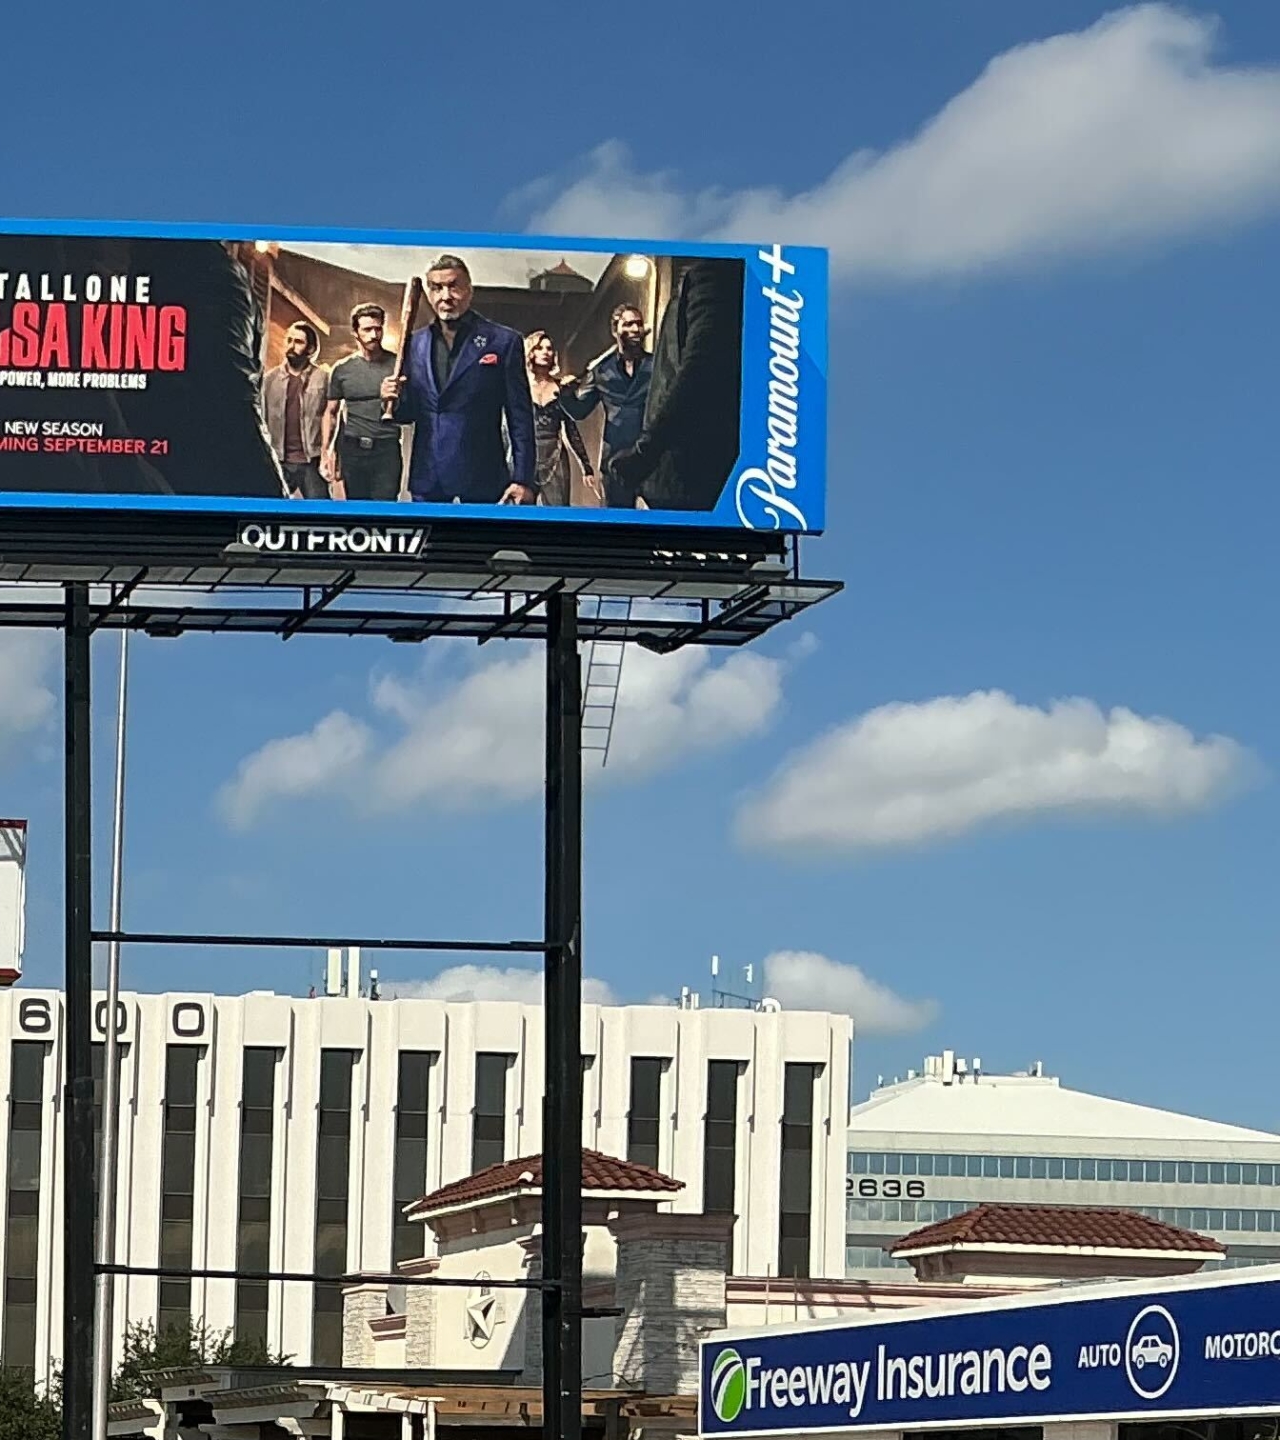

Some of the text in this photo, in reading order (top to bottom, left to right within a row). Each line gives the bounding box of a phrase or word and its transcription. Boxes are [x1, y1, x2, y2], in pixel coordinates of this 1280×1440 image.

[81, 303, 188, 371] KING
[0, 370, 45, 389] POWER,
[47, 372, 81, 388] MORE
[83, 372, 147, 390] PROBLEMS
[735, 243, 808, 531] Paramount+
[4, 420, 104, 437] NEW SEASON
[43, 438, 146, 455] SEPTEMBER
[151, 439, 169, 455] 21
[743, 1356, 871, 1419] Freeway
[877, 1343, 1052, 1401] Insurance
[1077, 1341, 1122, 1369] AUTO
